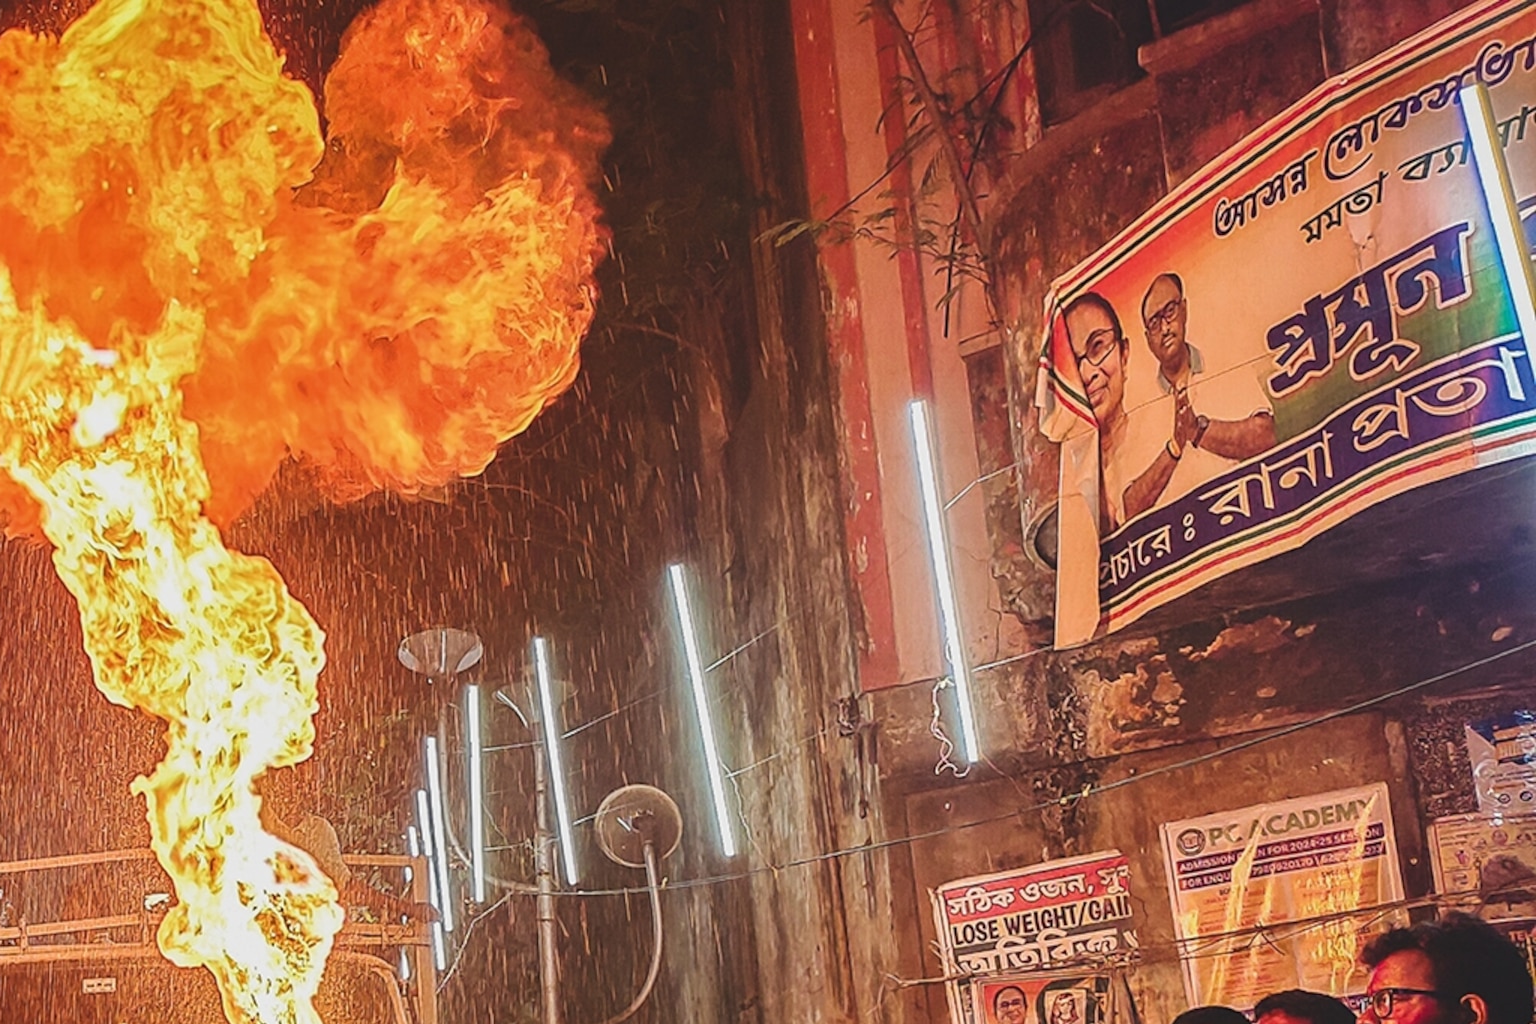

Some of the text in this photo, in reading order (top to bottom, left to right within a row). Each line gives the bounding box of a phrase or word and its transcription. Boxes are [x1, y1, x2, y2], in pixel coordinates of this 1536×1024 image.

[1300, 171, 1388, 244] মমতা
[1198, 430, 1334, 526] রানা
[947, 886, 1015, 916] সঠিক
[952, 919, 999, 946] LOSE
